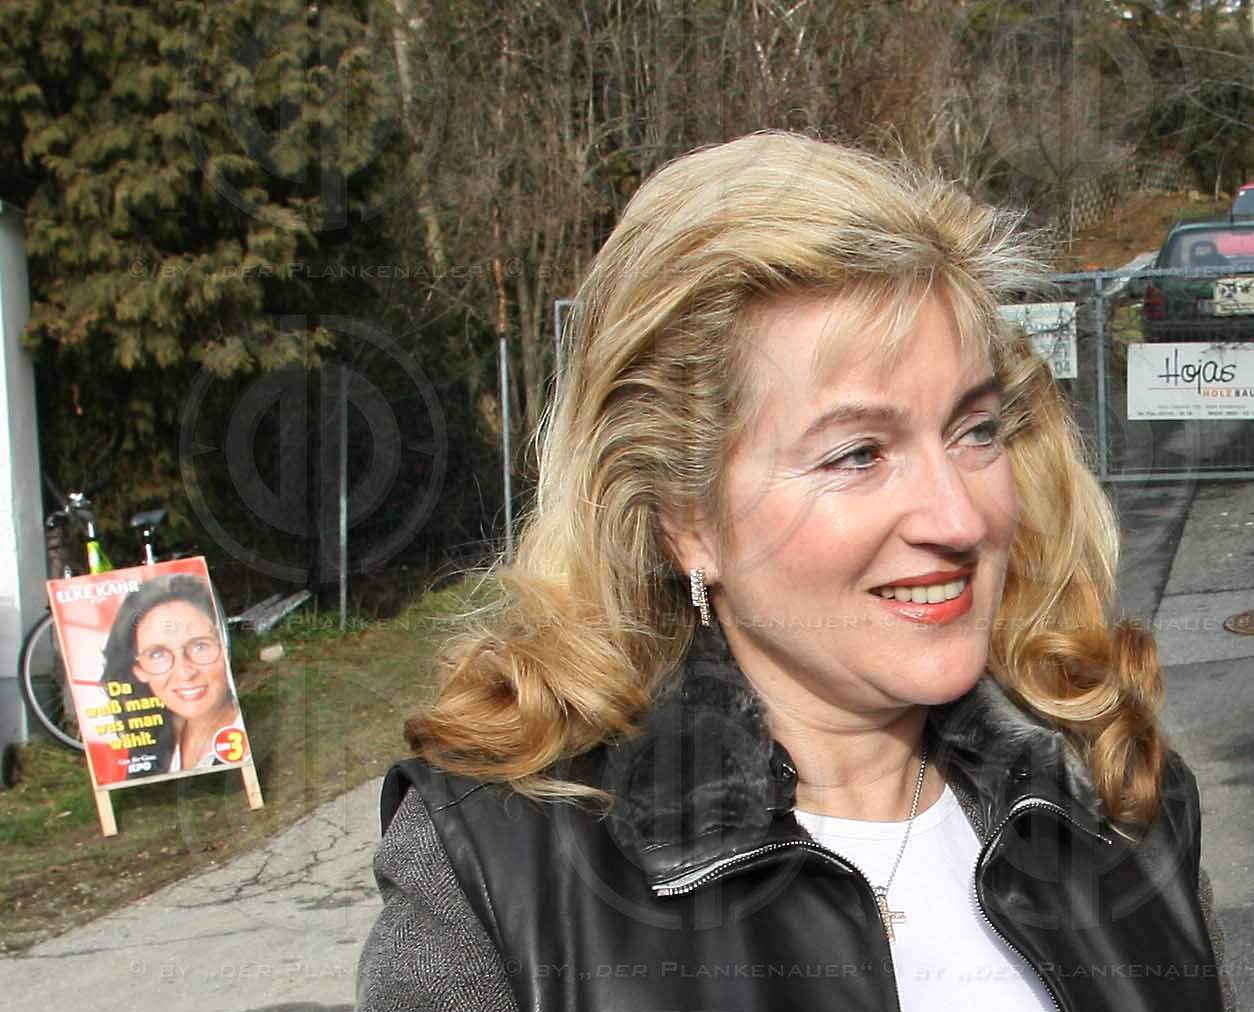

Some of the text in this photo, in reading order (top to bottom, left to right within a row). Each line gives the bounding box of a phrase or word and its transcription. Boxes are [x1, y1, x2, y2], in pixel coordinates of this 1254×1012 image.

[1158, 348, 1238, 394] Hojas
[107, 681, 132, 697] Da
[128, 713, 164, 728] man
[226, 731, 245, 762] 3
